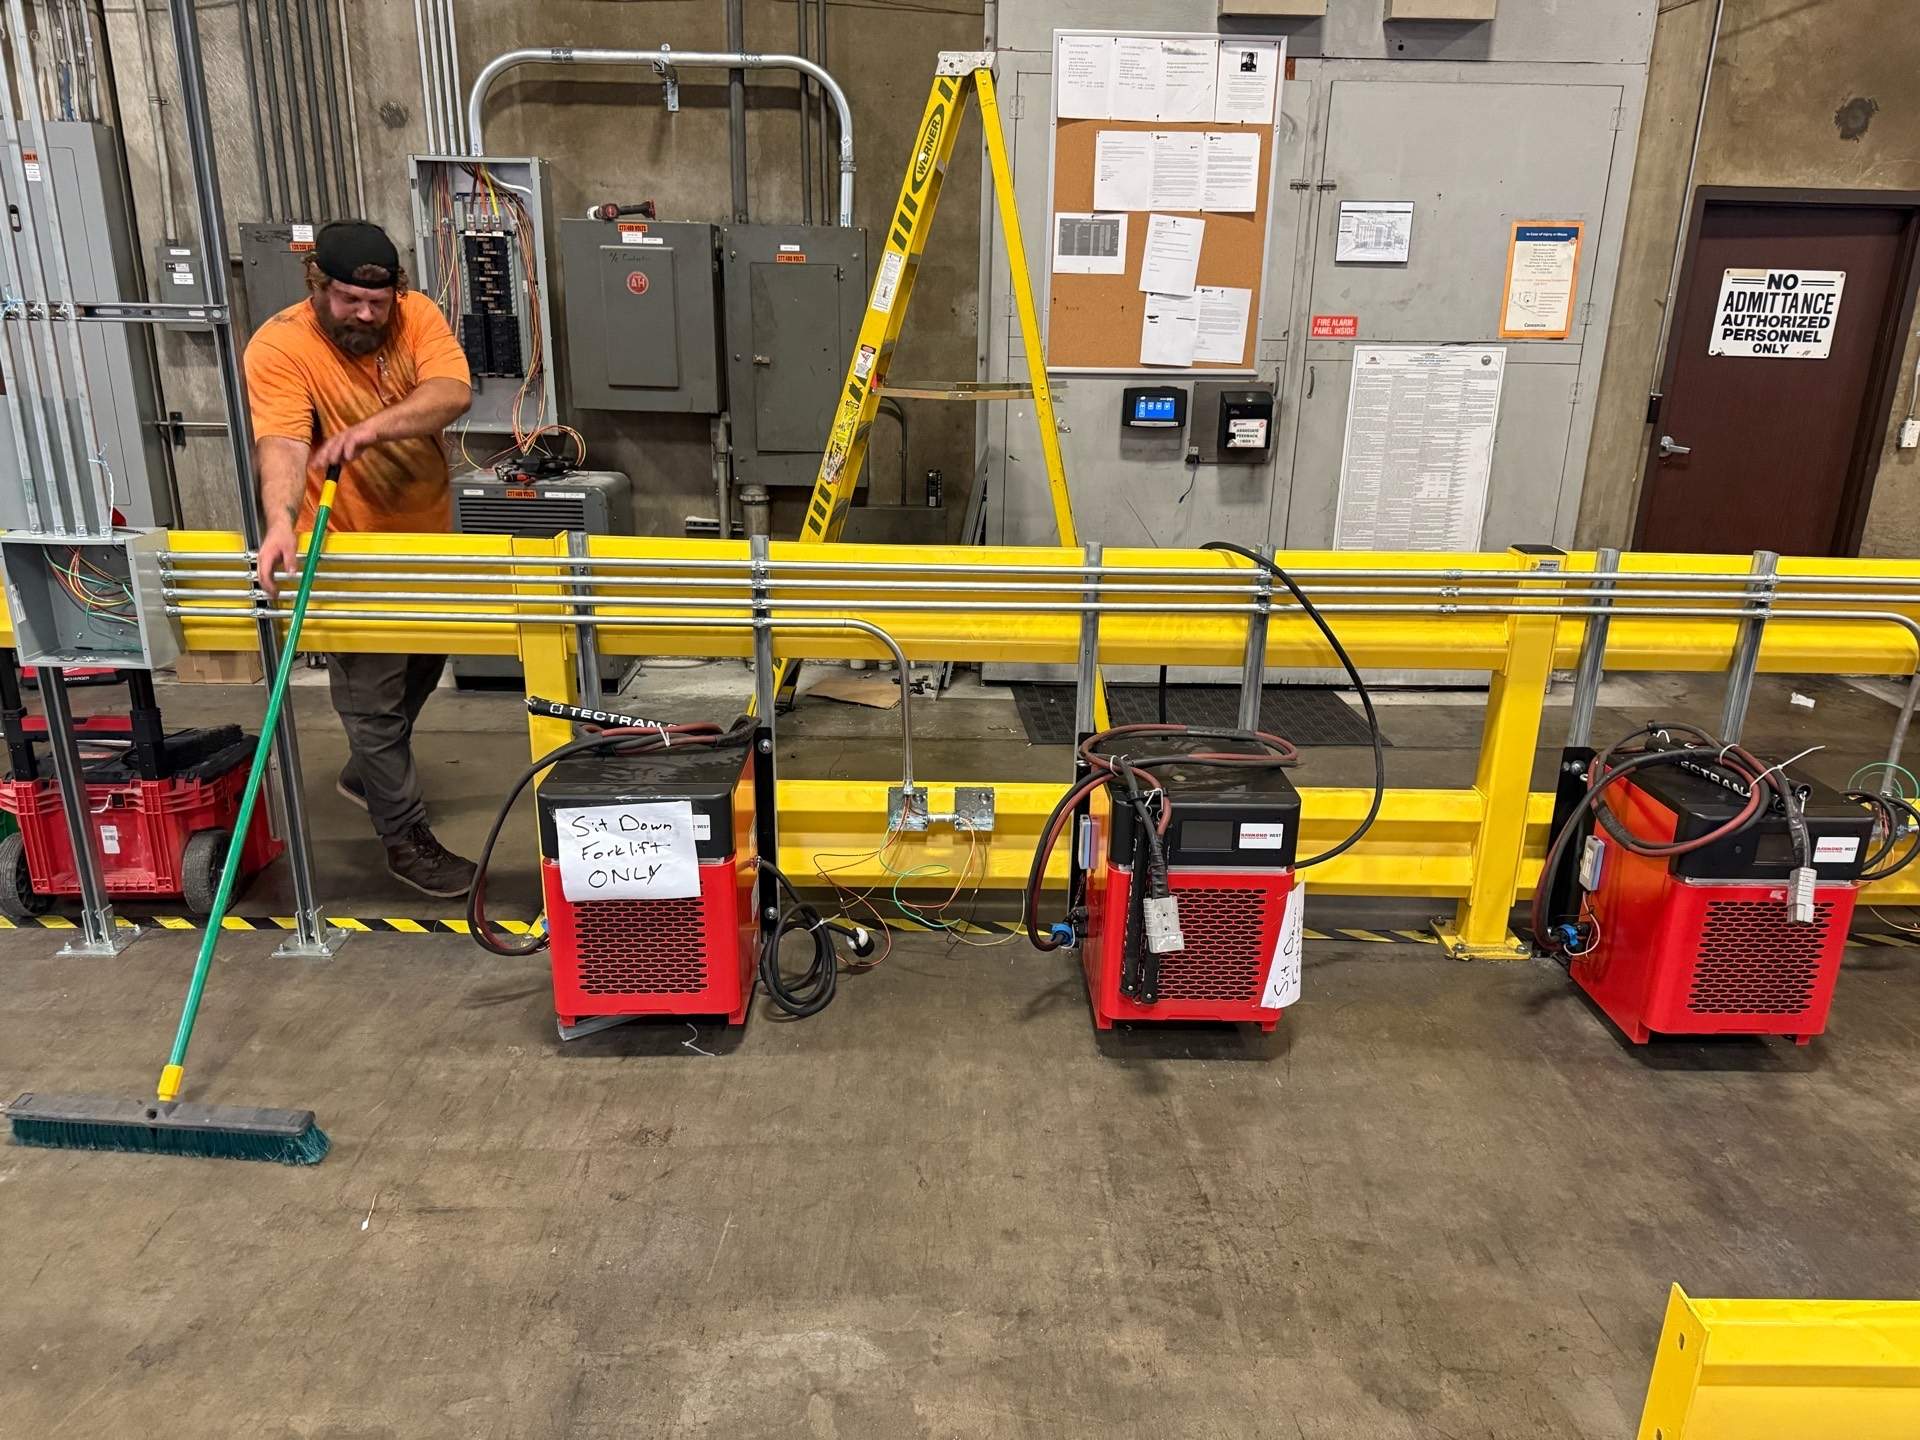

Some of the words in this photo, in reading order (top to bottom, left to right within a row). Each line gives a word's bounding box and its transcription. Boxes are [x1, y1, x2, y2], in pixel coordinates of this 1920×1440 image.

[917, 119, 940, 175] WERNER
[1767, 274, 1799, 290] NO
[1723, 291, 1836, 314] ADMITTANCE
[1313, 327, 1333, 335] PANEL
[1317, 318, 1331, 327] FIRE
[1332, 319, 1354, 327] ALARM
[1721, 314, 1830, 329] AUTHORIZED
[1722, 329, 1822, 343] PERSONNEL
[1752, 343, 1789, 354] ONLY
[570, 702, 661, 728] TECTRAN
[1680, 760, 1751, 798] ECTRAN
[572, 816, 607, 838] Sit
[619, 815, 672, 832] Down
[588, 864, 662, 888] ONLY
